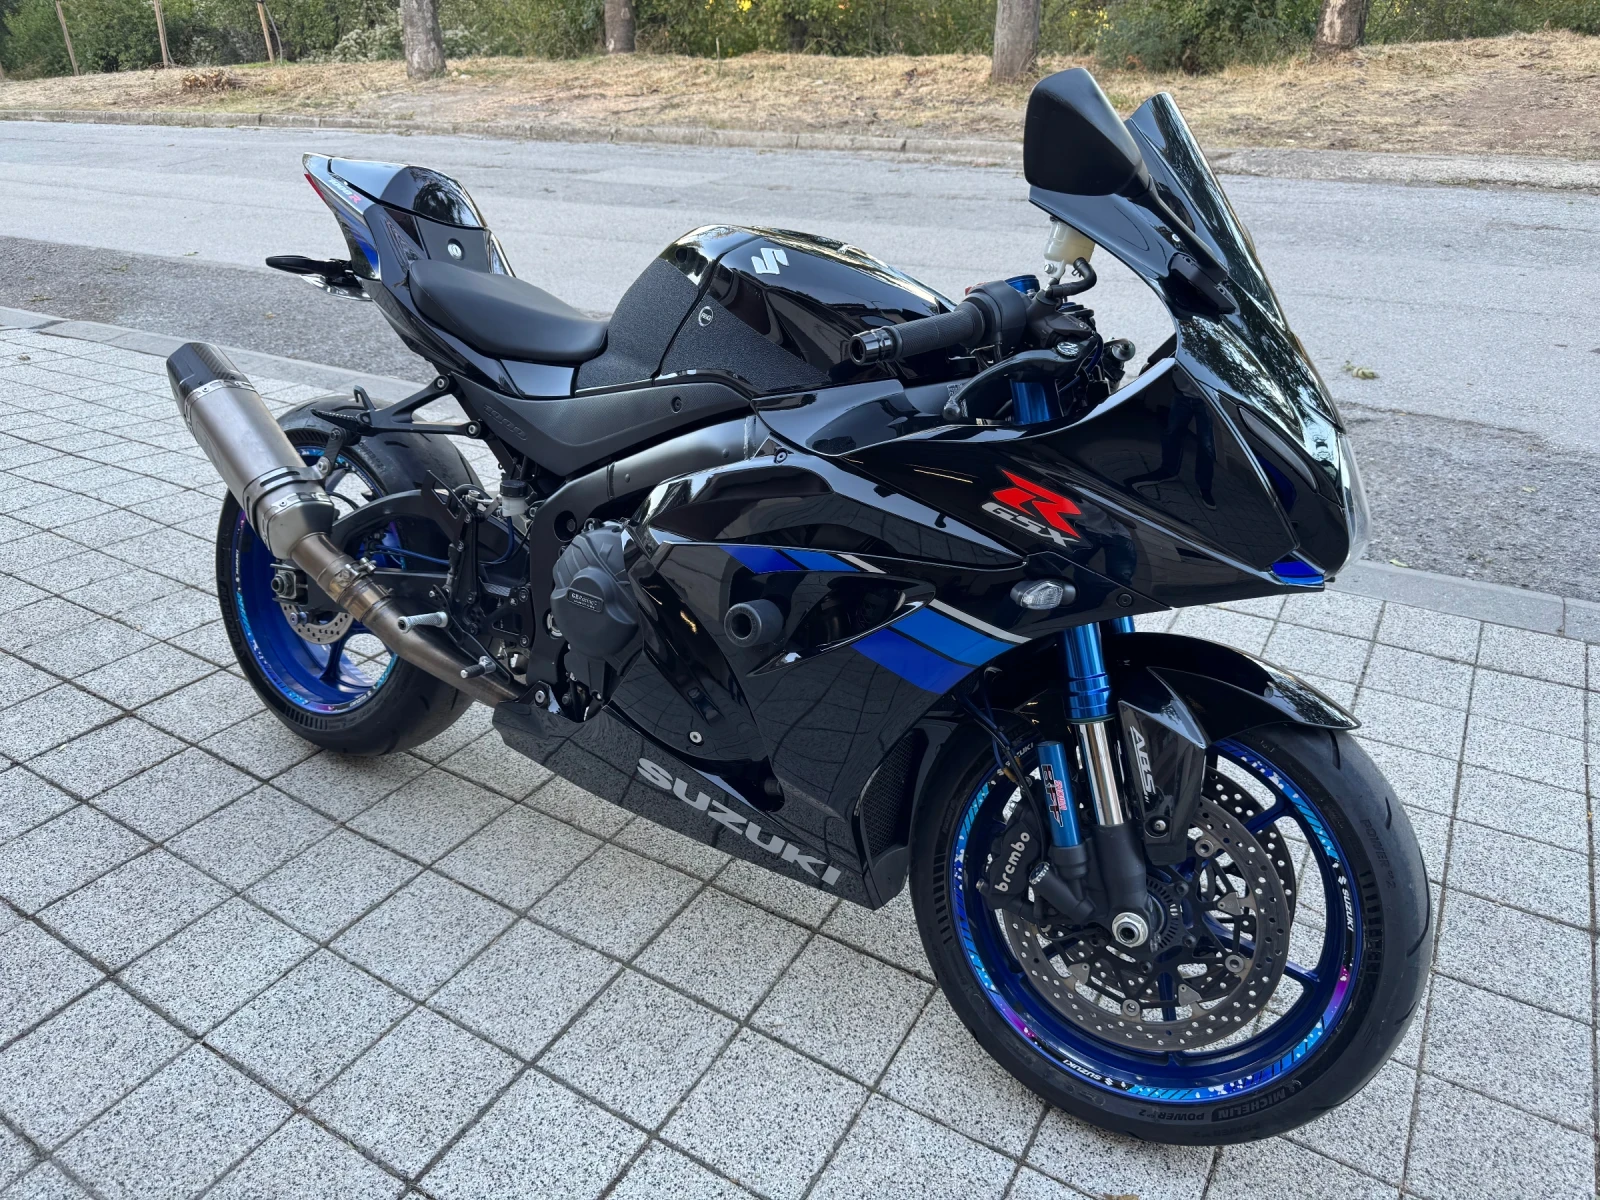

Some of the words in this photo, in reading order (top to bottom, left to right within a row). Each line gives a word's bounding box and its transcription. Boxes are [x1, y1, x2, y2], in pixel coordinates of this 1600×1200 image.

[981, 502, 1080, 547] GSX
[1129, 725, 1157, 803] ABS
[637, 757, 841, 886] SUZUKI
[994, 832, 1030, 892] brembo
[1341, 887, 1354, 932] SUZUKI
[1063, 1059, 1103, 1081] SUZUKI
[1157, 1111, 1205, 1121] POWER
[1218, 1088, 1286, 1120] MICHELIN
